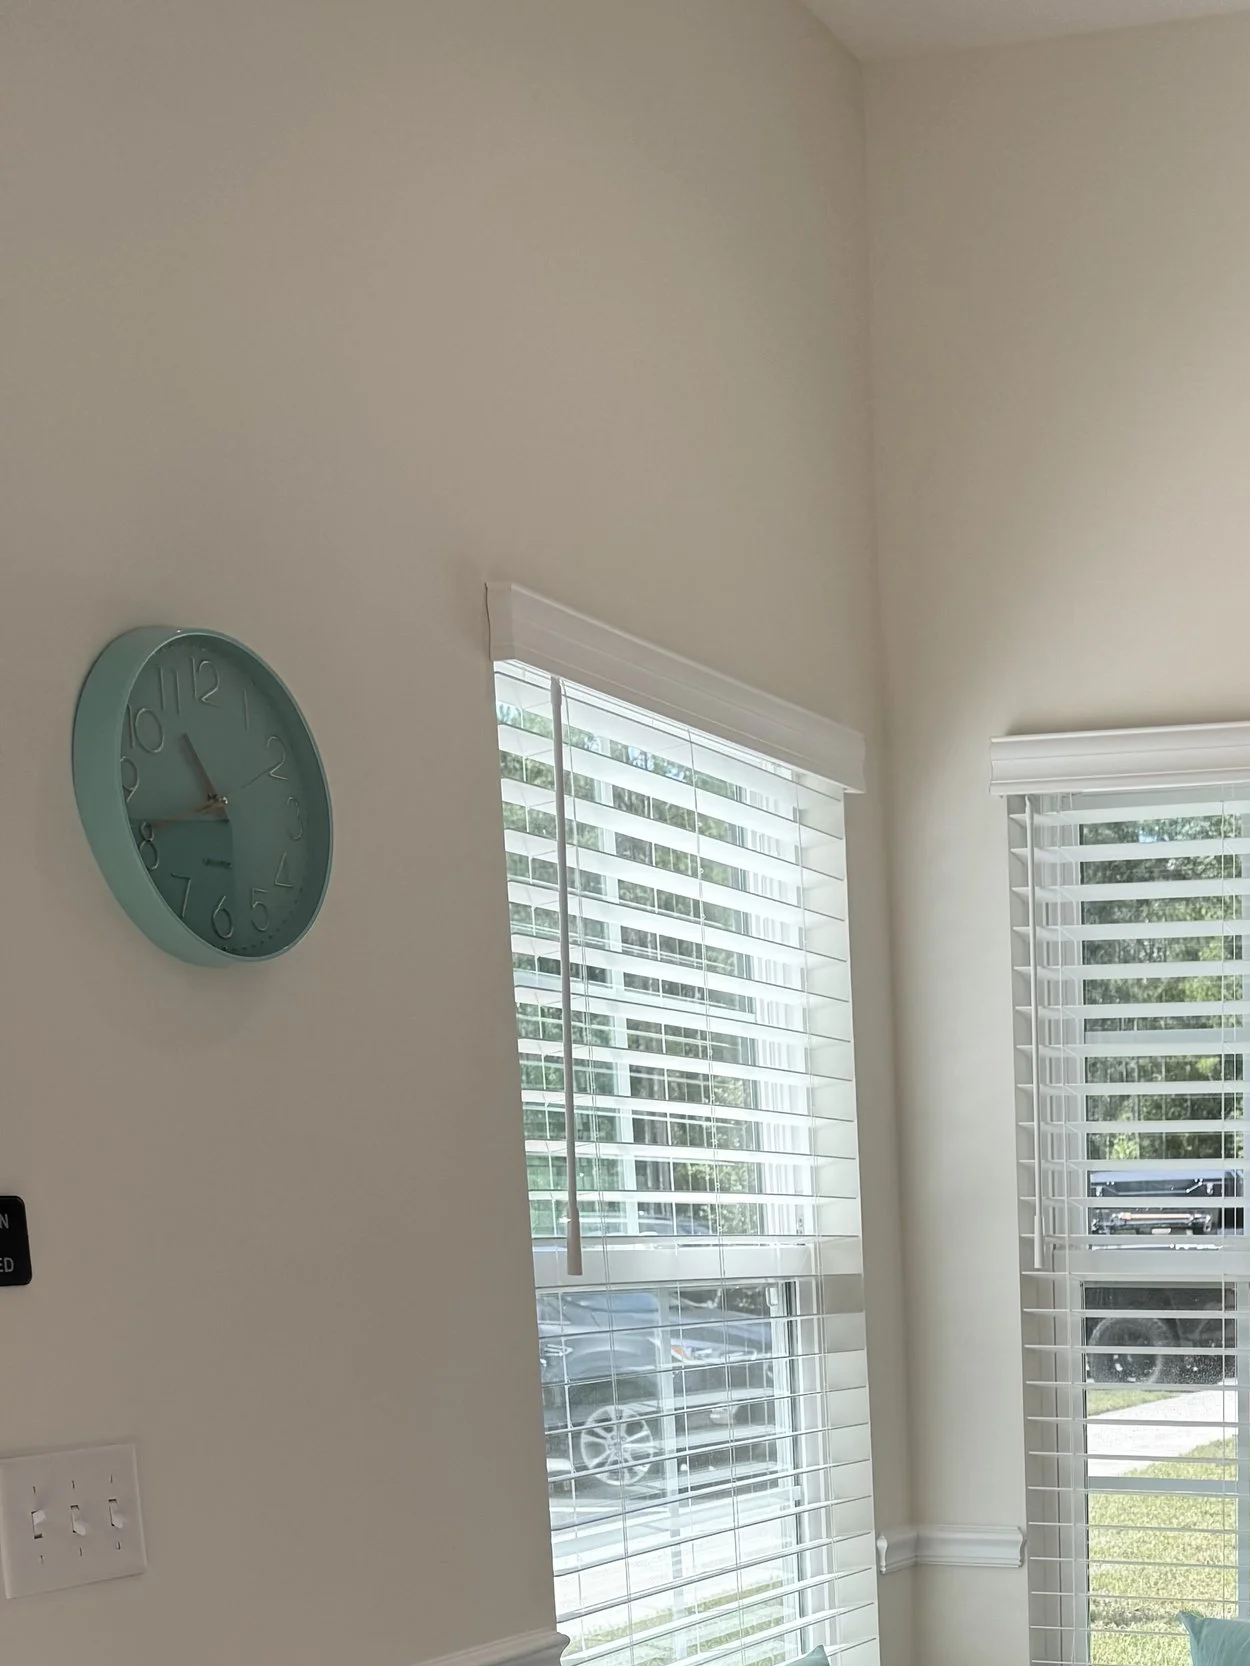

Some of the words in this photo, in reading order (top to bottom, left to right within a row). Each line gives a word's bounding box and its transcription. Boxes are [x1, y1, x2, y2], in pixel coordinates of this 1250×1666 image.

[191, 655, 221, 708] 12
[126, 704, 165, 753] 10
[265, 735, 289, 781] 2
[286, 796, 304, 841] 3
[140, 821, 160, 870] 8
[170, 873, 192, 918] 7
[212, 895, 234, 940] 6
[251, 887, 270, 932] 5
